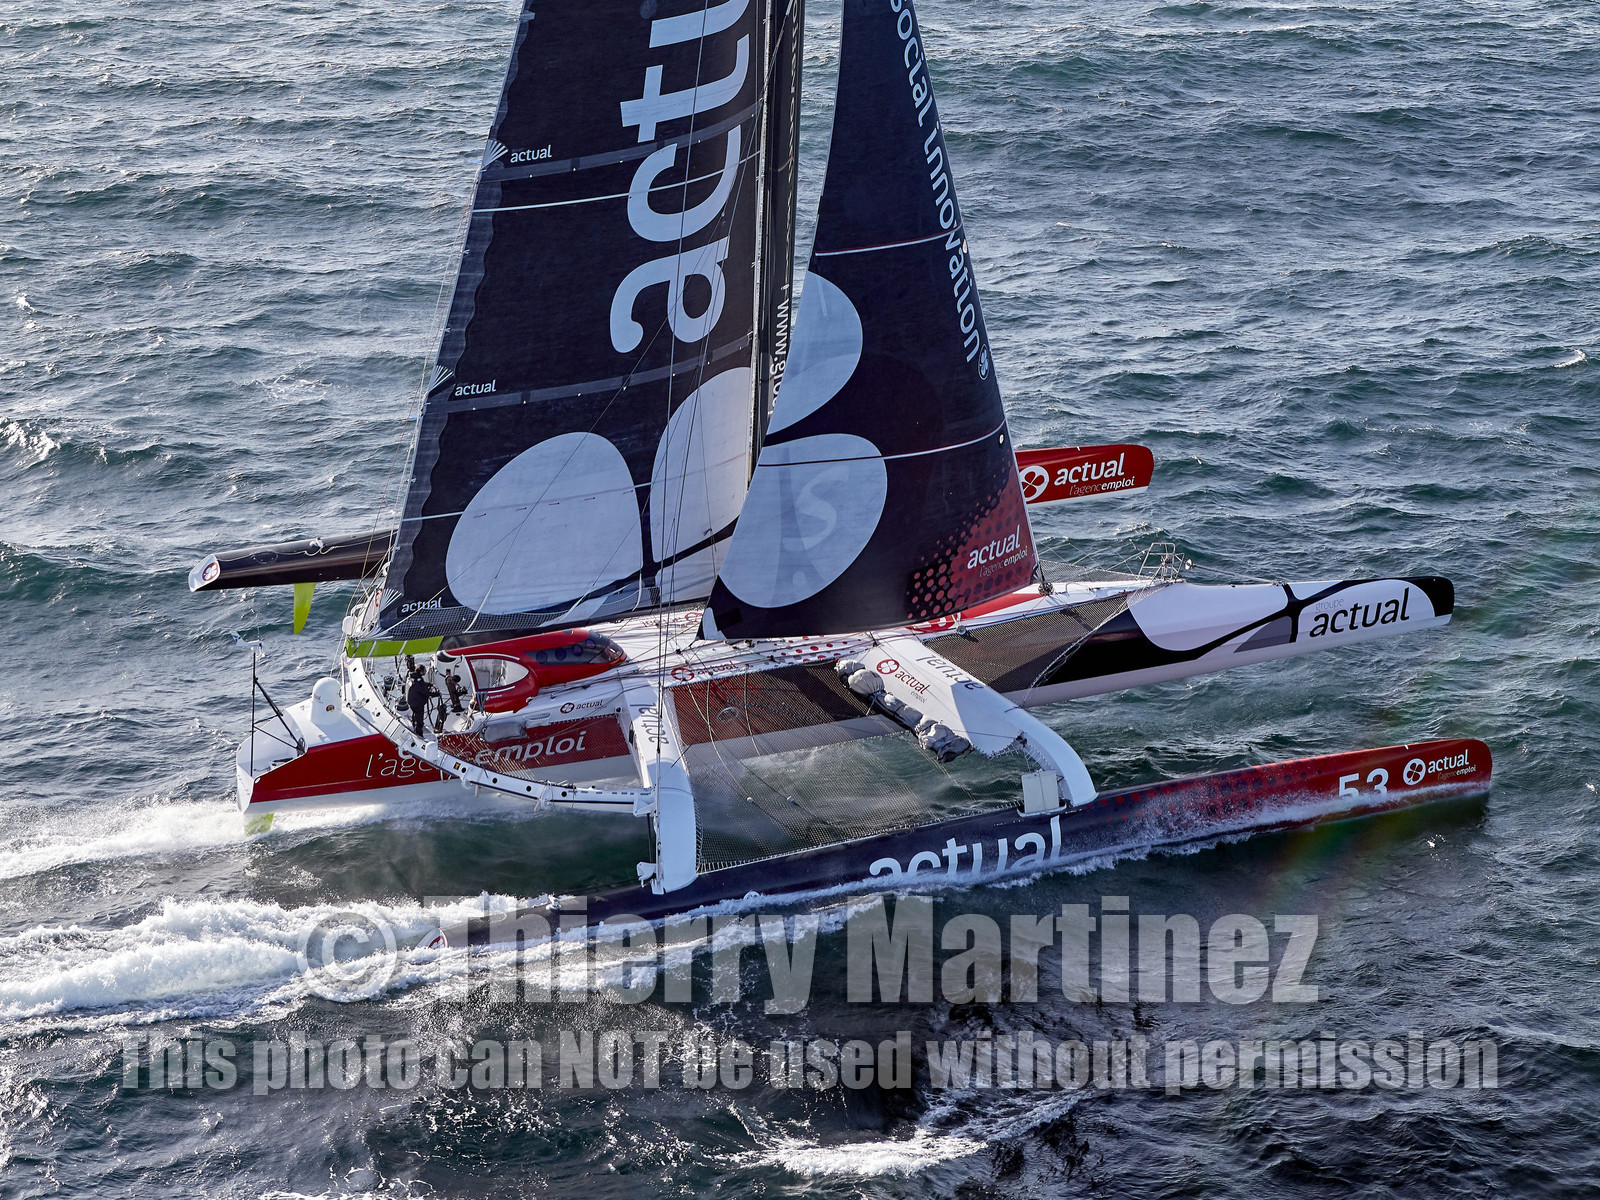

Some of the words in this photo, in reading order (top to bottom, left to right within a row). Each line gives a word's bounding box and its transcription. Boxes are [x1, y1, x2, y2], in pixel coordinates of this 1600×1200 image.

[510, 144, 552, 164] actual
[923, 120, 981, 363] innovation
[454, 379, 497, 397] actual
[1054, 452, 1125, 486] actual
[967, 524, 1020, 570] actual
[401, 596, 442, 613] actual
[1309, 587, 1409, 638] actual
[1315, 597, 1344, 613] groupe
[895, 669, 931, 695] actual
[916, 653, 985, 690] actual
[576, 699, 604, 709] actual
[630, 702, 669, 744] actual
[1427, 748, 1470, 774] actual
